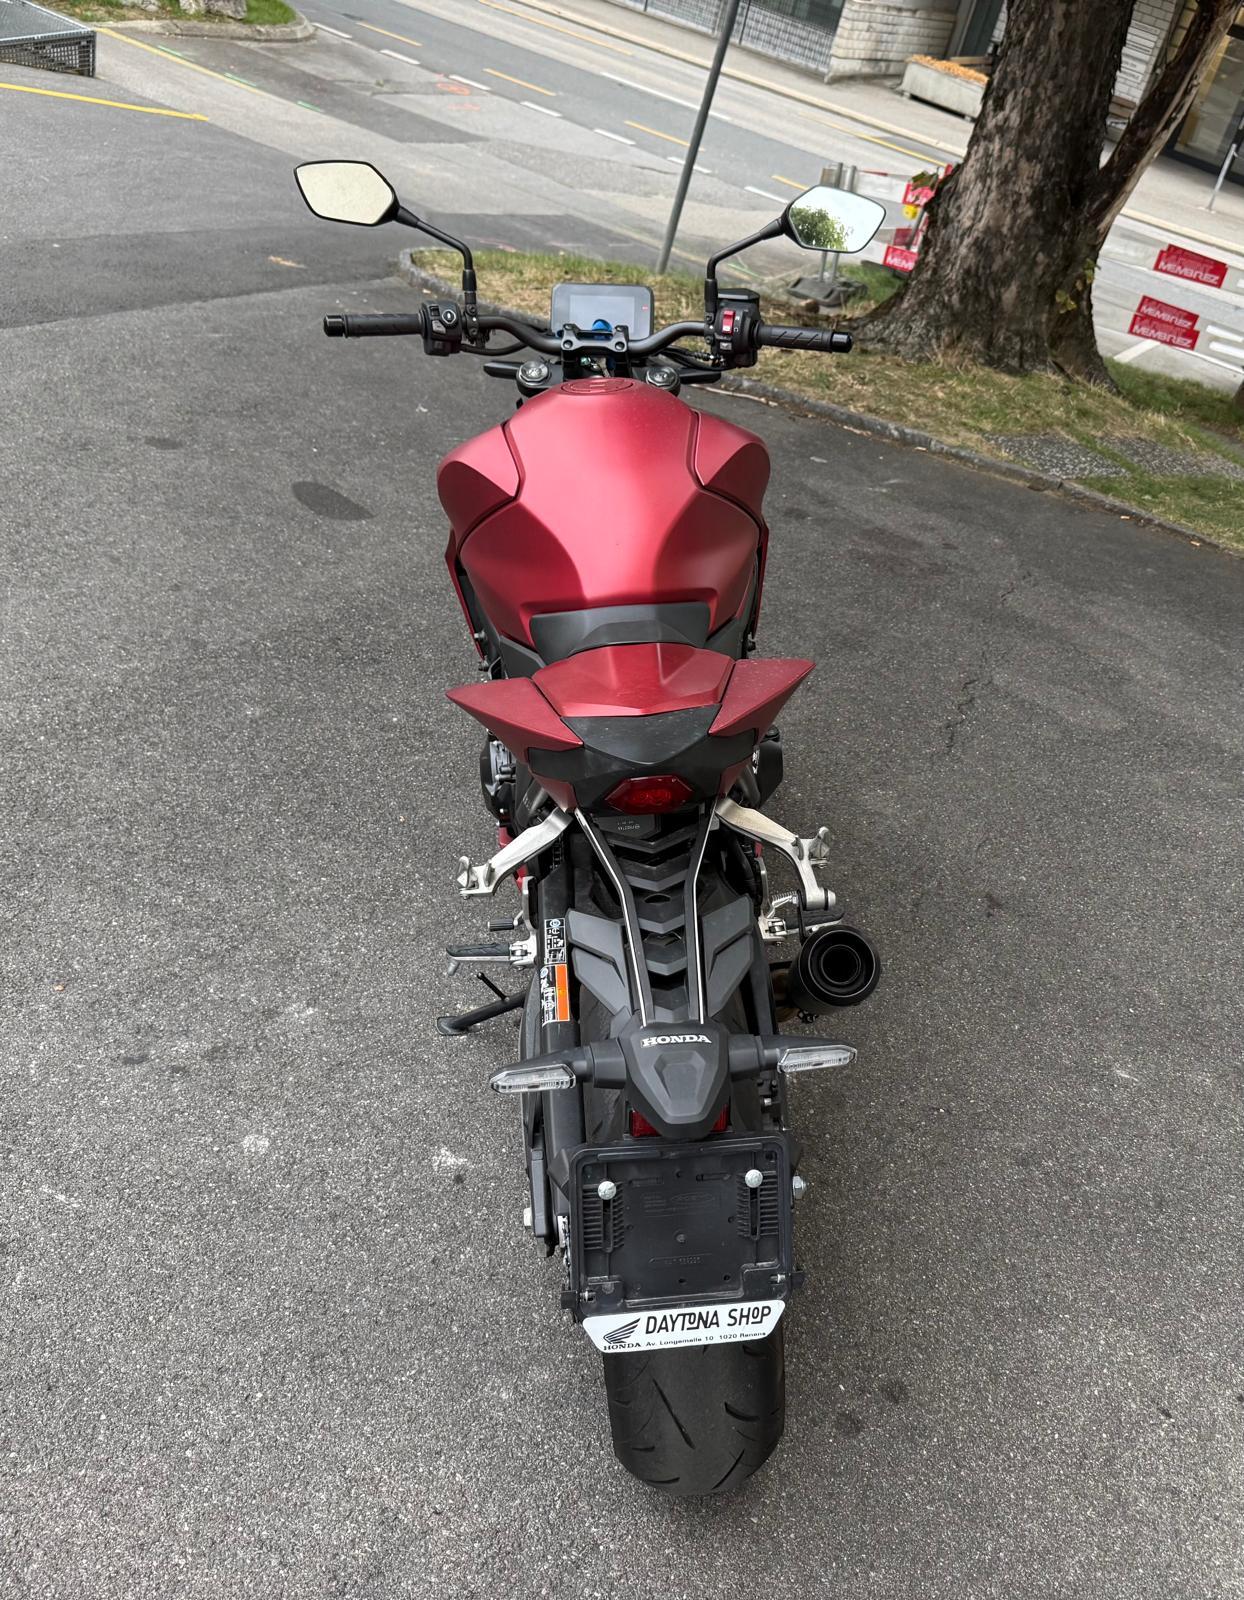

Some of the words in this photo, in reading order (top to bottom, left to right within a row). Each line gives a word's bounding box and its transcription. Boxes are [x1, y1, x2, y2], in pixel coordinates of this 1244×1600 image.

[641, 1034, 712, 1048] HONDA
[645, 1310, 720, 1334] DAYTONA
[727, 1305, 771, 1326] SHOP
[603, 1342, 642, 1351] HONDA
